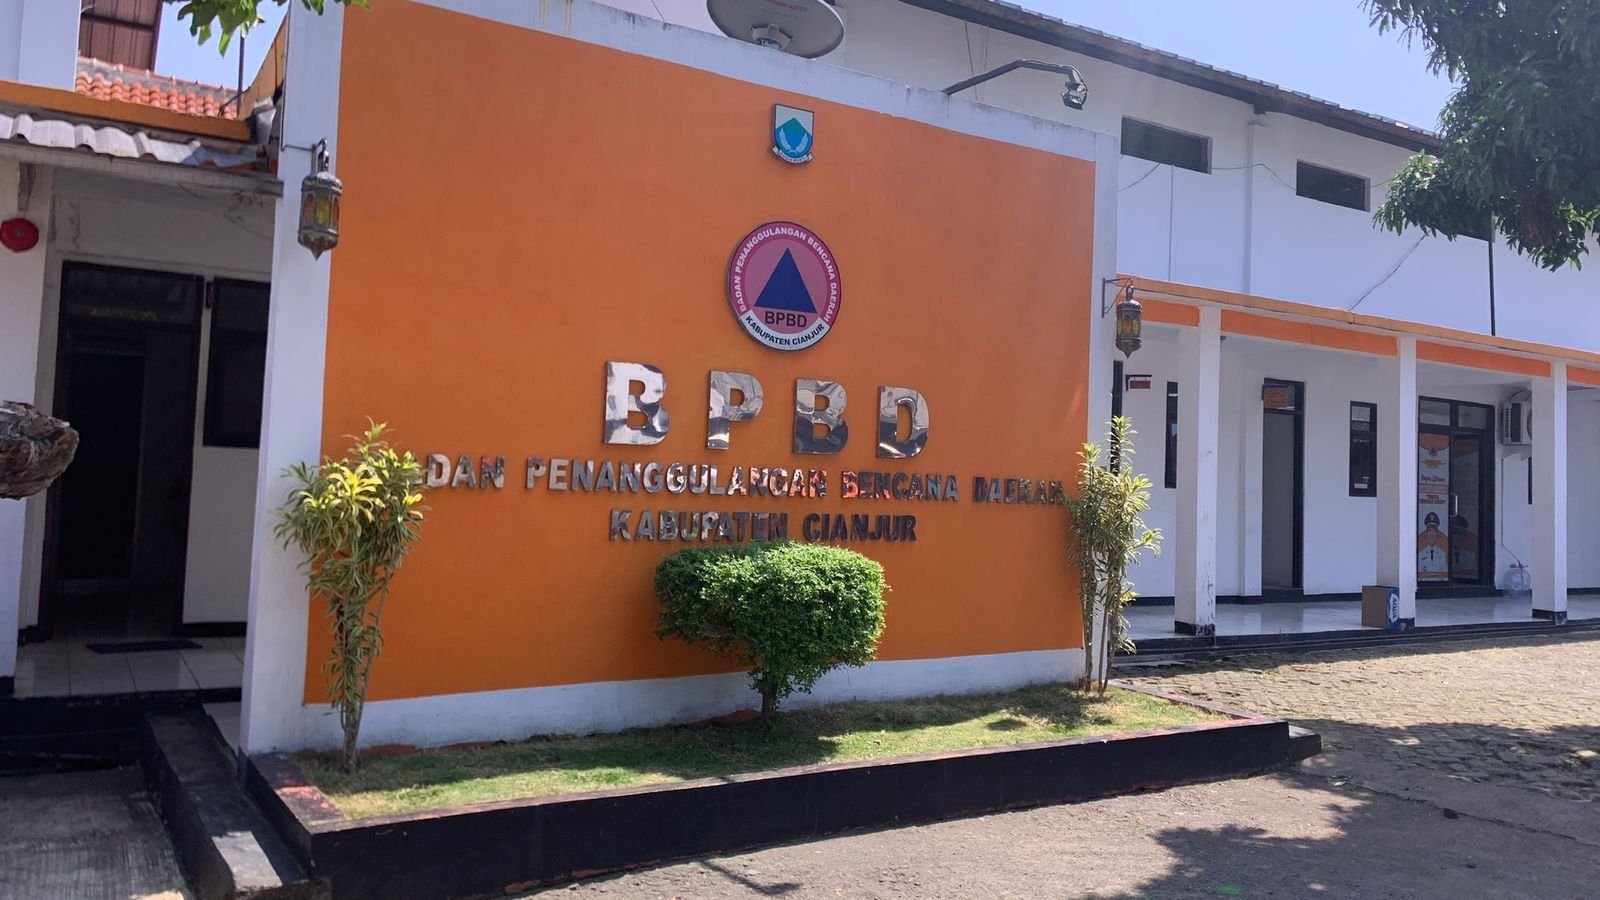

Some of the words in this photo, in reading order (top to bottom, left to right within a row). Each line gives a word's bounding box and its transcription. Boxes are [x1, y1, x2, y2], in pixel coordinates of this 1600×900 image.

[735, 227, 807, 273] PENANGGULANGAN
[807, 238, 836, 280] BENCANA
[734, 275, 747, 312] BADAN
[824, 282, 837, 322] DAERAH
[745, 315, 791, 346] KABUPATEN
[792, 323, 825, 346] CIANJUR
[765, 311, 807, 328] BPBD
[604, 361, 930, 460] BPBD
[412, 453, 505, 489] DAN
[526, 456, 828, 499] PENANGGULANGAN
[841, 470, 960, 502] BENCANA
[972, 476, 1065, 505] DAERAH
[610, 508, 789, 542] KABUPATEN
[802, 513, 917, 542] CIANJUR
